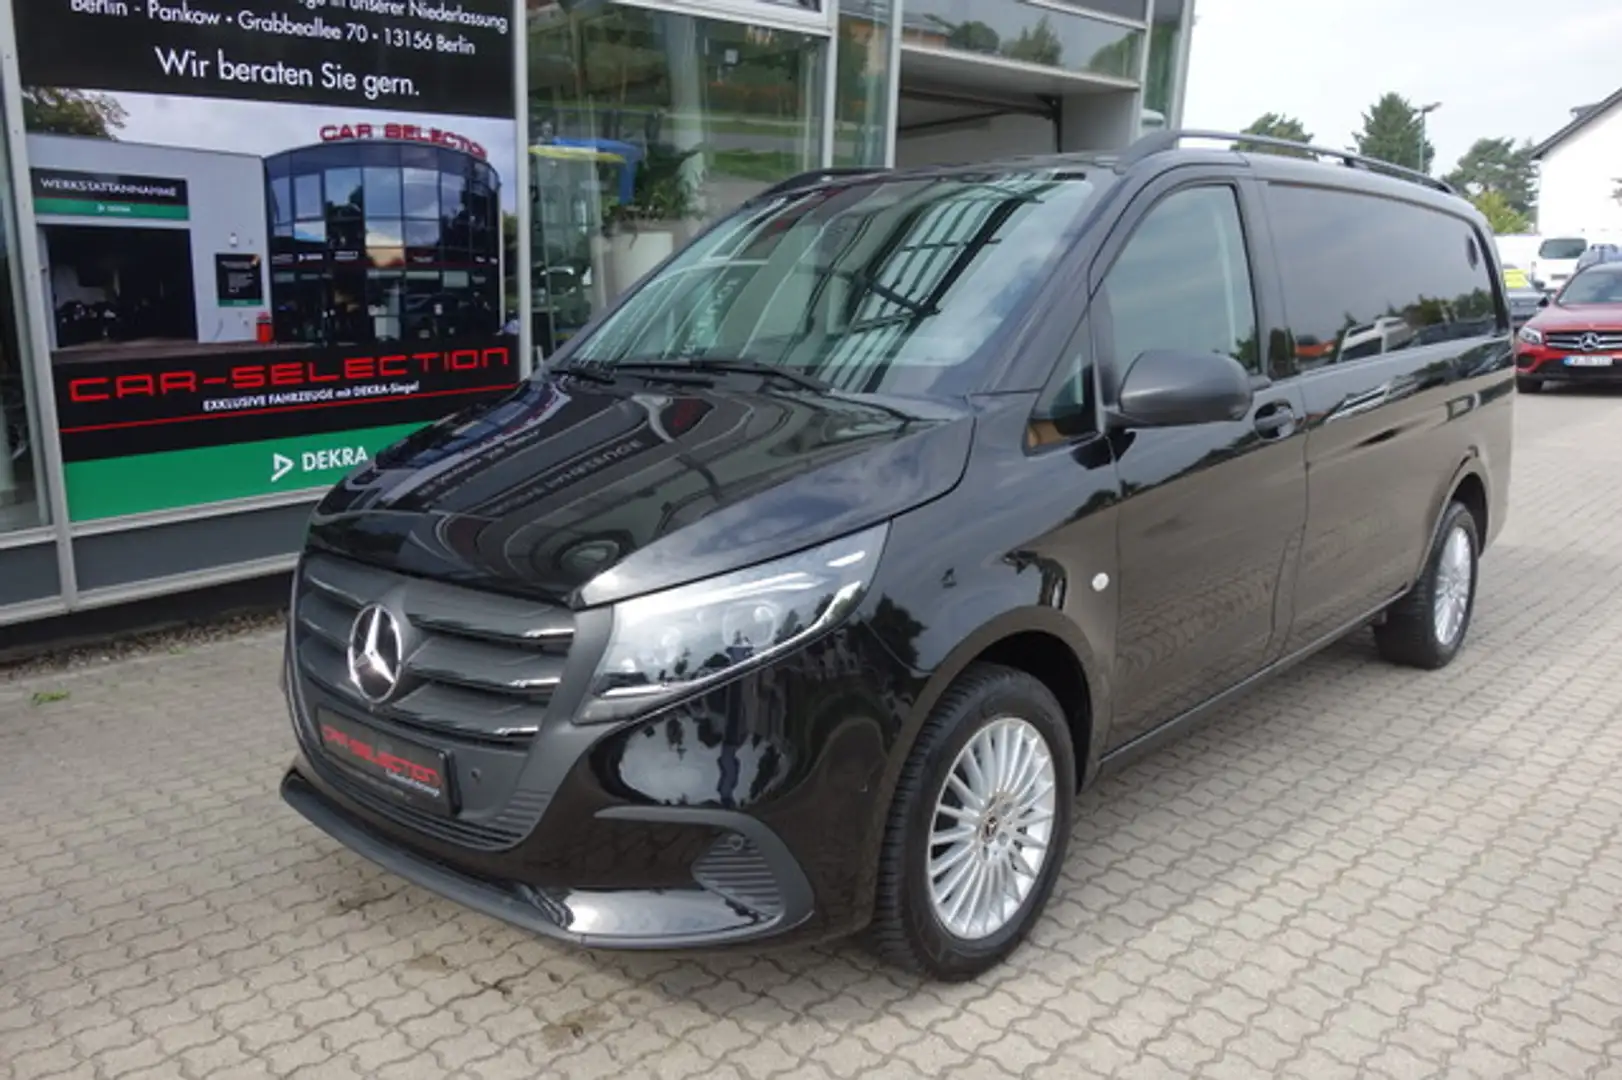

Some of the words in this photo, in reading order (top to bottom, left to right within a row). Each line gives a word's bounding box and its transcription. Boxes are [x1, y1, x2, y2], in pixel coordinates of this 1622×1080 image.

[71, 0, 128, 16] Berlin
[148, 0, 221, 26] Pankow
[237, 10, 342, 40] Grabbeallee
[346, 23, 369, 43] 70
[384, 27, 433, 50] 13156
[436, 33, 476, 55] Berlin
[409, 2, 509, 35] Niederlassung
[154, 46, 210, 78] Wir
[217, 48, 313, 87] beraten
[321, 63, 357, 90] Sie
[362, 74, 420, 100] gern.
[319, 123, 373, 142] CAR
[69, 347, 509, 402] CAR-SELECTION
[203, 395, 267, 412] EXKLUSIVE
[268, 388, 334, 405] FAHRZEUGE
[336, 388, 351, 398] mit
[353, 380, 420, 397] DEKRA-Siegel
[302, 446, 369, 472] DEKRA
